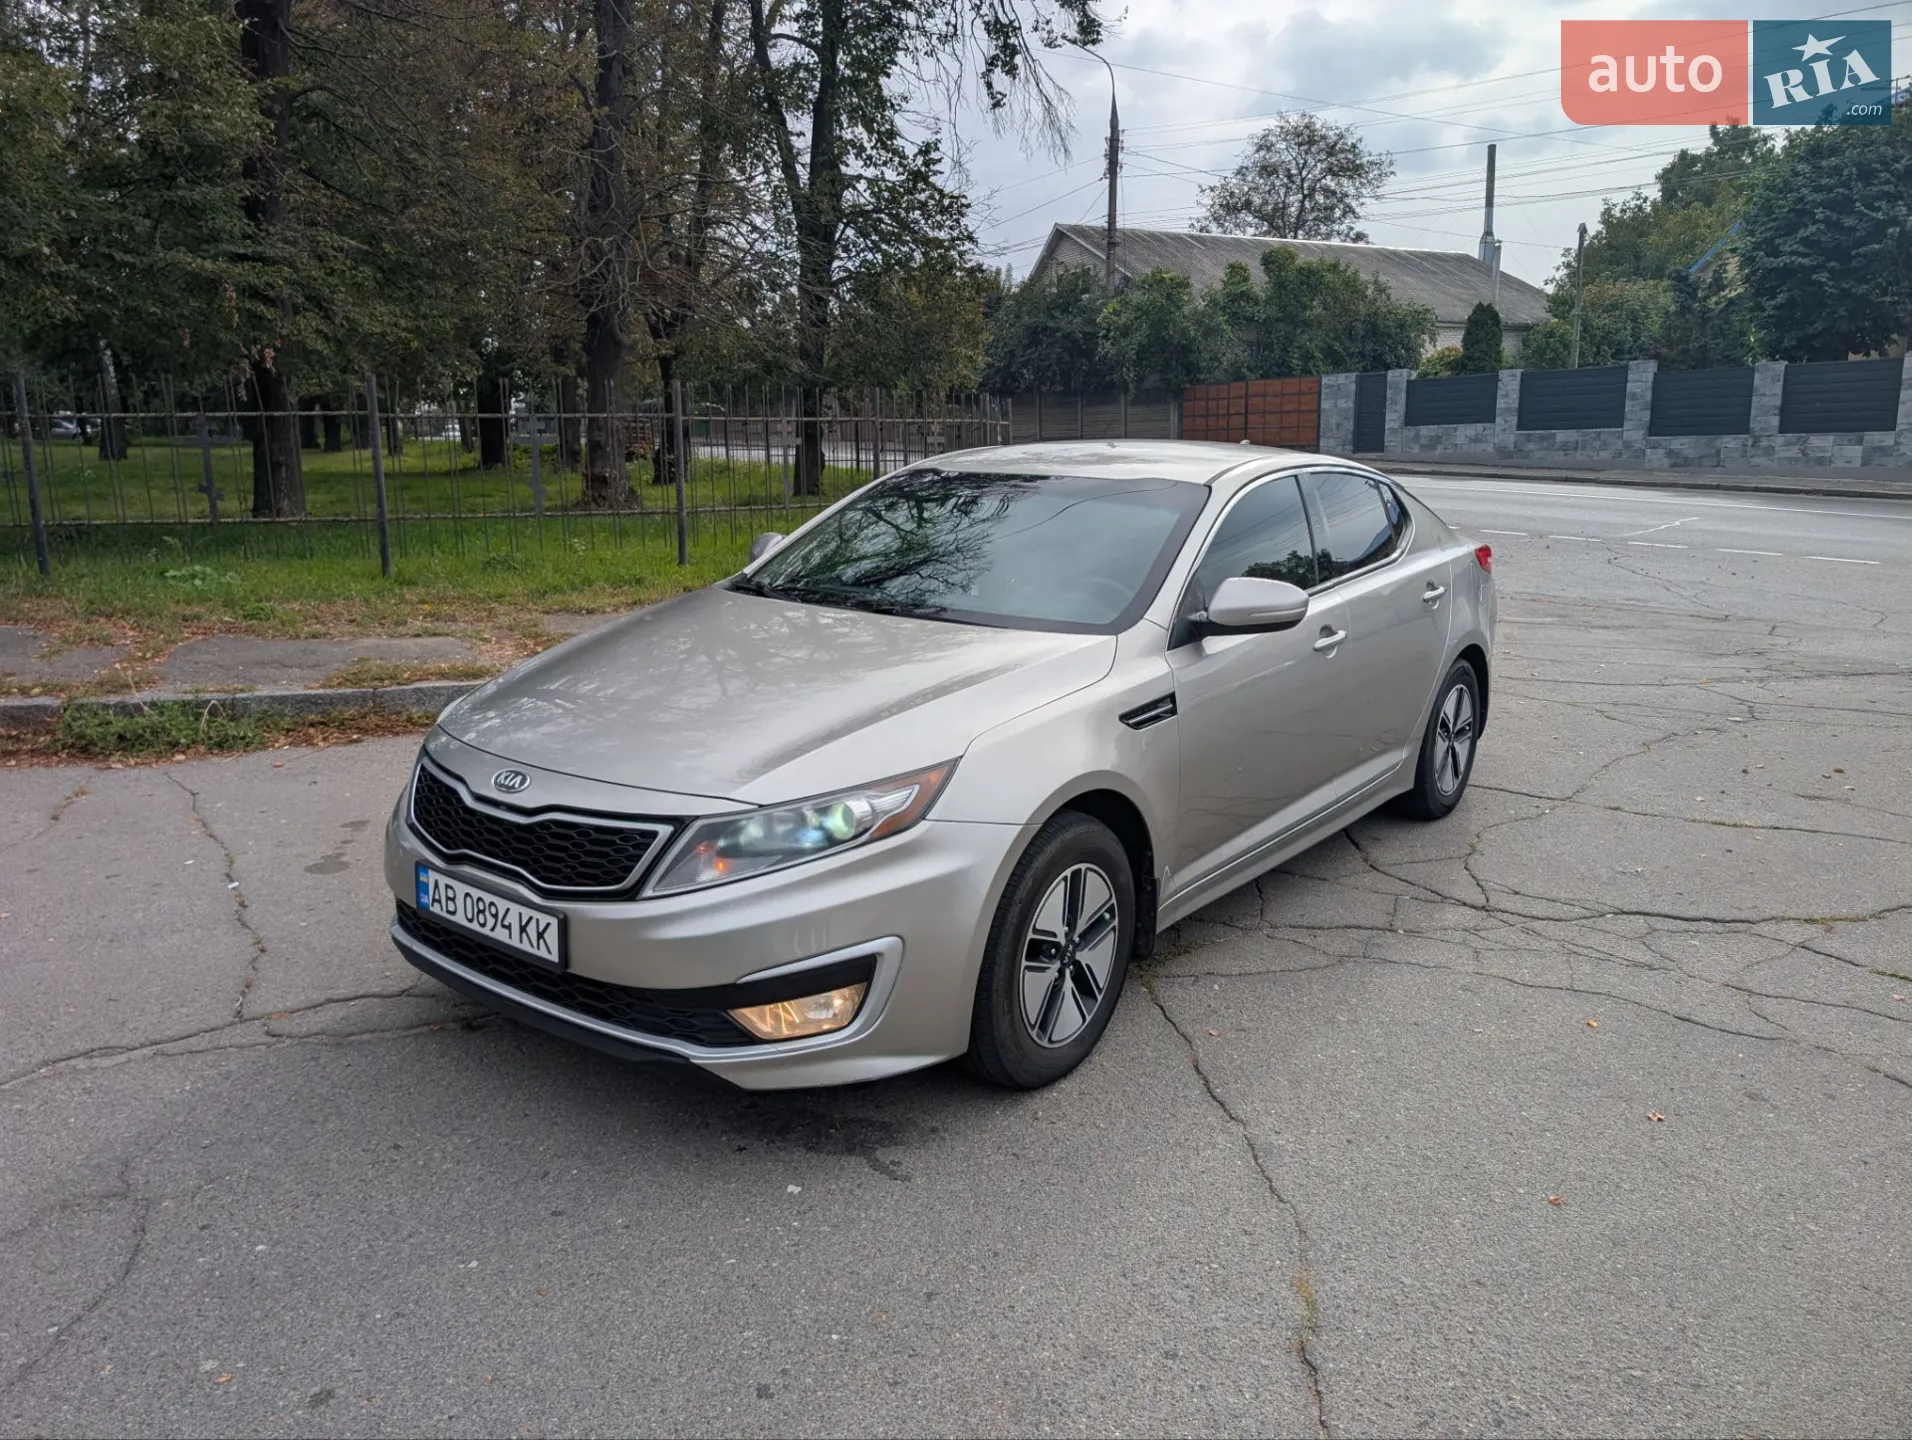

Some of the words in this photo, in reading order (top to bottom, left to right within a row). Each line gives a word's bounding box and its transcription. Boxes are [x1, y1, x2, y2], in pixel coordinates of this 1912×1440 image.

[496, 771, 523, 789] KIA
[431, 879, 457, 916] AB
[463, 892, 513, 940] 0894
[519, 911, 553, 956] KK
